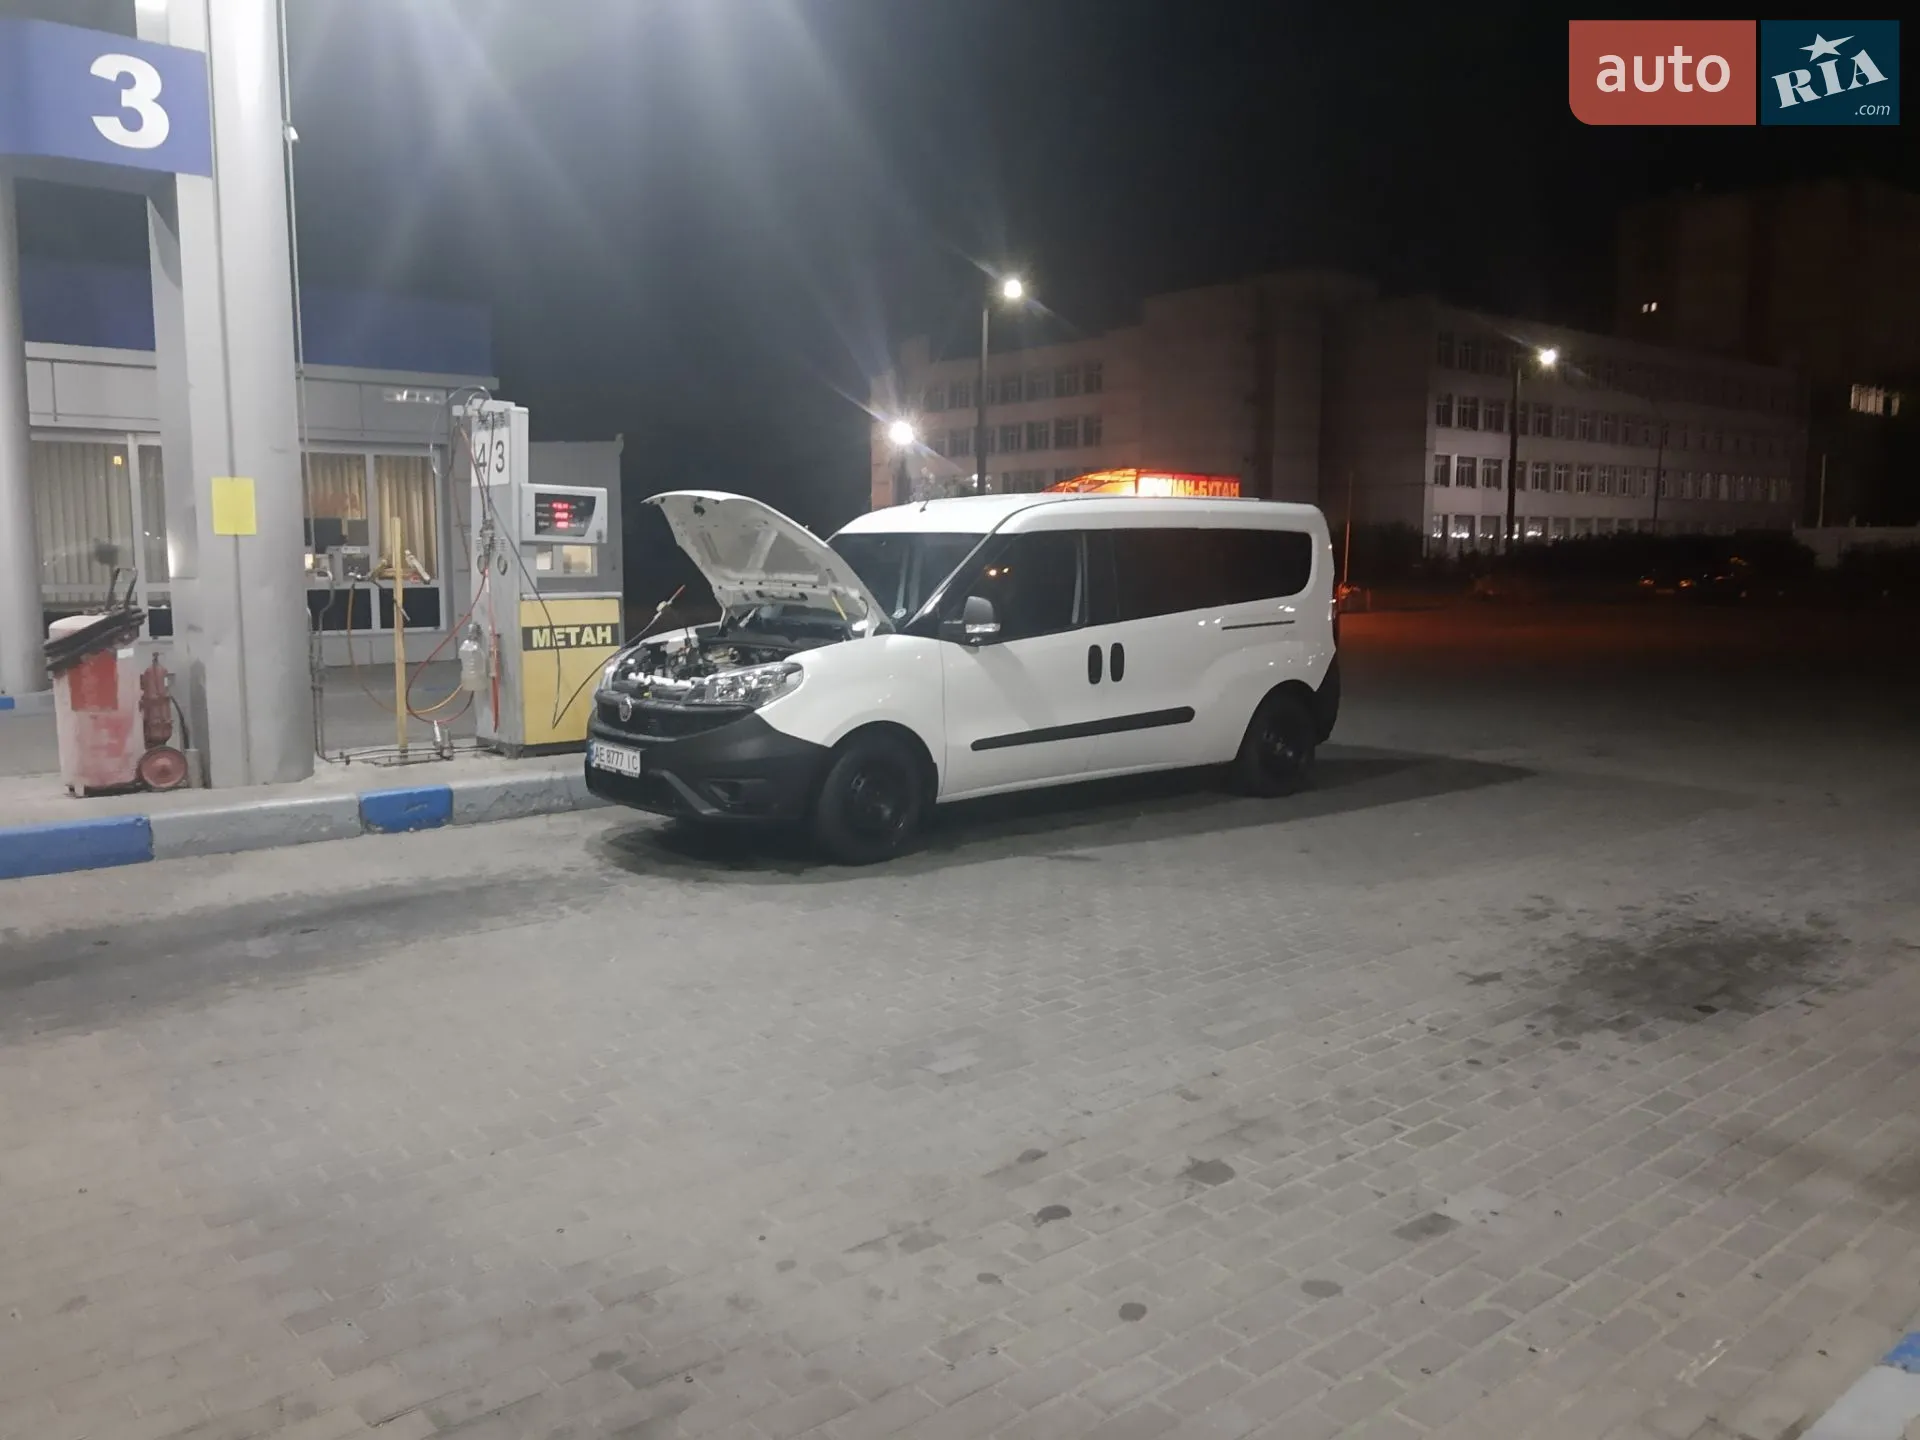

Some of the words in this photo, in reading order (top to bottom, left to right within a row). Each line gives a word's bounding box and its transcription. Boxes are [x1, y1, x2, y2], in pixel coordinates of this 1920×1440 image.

[90, 53, 170, 149] 3
[1138, 477, 1240, 497] АН-БУТАН
[532, 625, 611, 648] МЕТАН
